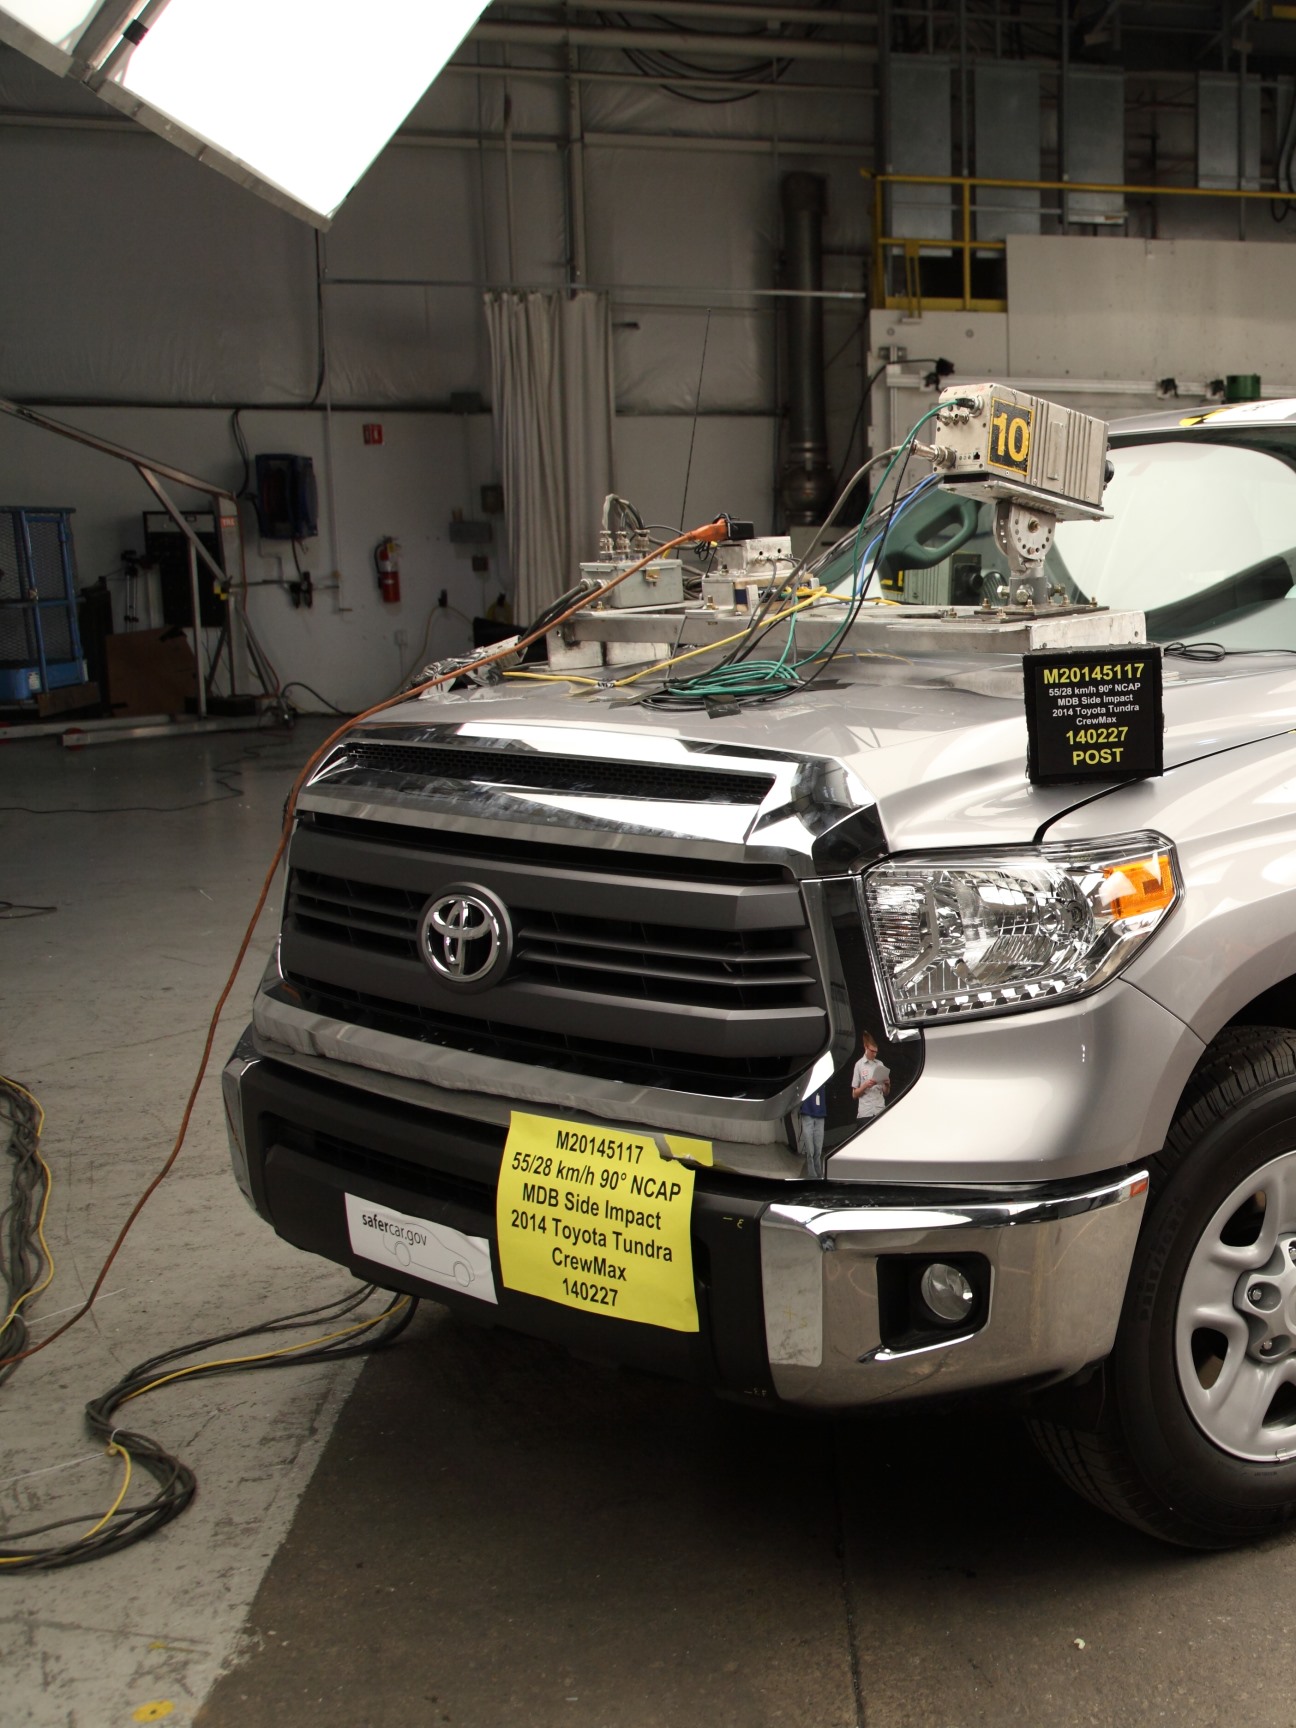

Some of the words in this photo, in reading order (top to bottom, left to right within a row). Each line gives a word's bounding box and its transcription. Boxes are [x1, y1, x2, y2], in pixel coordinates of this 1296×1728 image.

[993, 412, 1029, 462] 10
[1043, 663, 1144, 684] M20145117
[1049, 687, 1072, 697] 55/28
[1074, 685, 1096, 695] km/h
[1115, 682, 1141, 692] NCAP
[1058, 697, 1079, 706] MDB
[1081, 696, 1101, 705] Side
[1103, 694, 1133, 704] Impact
[1052, 708, 1073, 717] 2014
[1075, 706, 1106, 717] Toyota
[1108, 704, 1139, 713] Tundra
[1076, 716, 1117, 725] CrewMax
[1065, 727, 1129, 745] 140227
[1072, 748, 1124, 765] POST
[555, 1130, 643, 1164] M20145117
[511, 1152, 552, 1177] 55/28
[555, 1160, 595, 1187] km/h
[630, 1175, 681, 1203] NCAP
[522, 1182, 559, 1208] MDB
[564, 1193, 600, 1217] Side
[605, 1200, 662, 1230] Impact
[362, 1212, 427, 1247] safercar.gov
[511, 1210, 547, 1234] 2014
[552, 1218, 607, 1247] Toyota
[612, 1231, 673, 1262] Tundra
[552, 1248, 627, 1282] CrewMax
[562, 1278, 618, 1307] 140227
